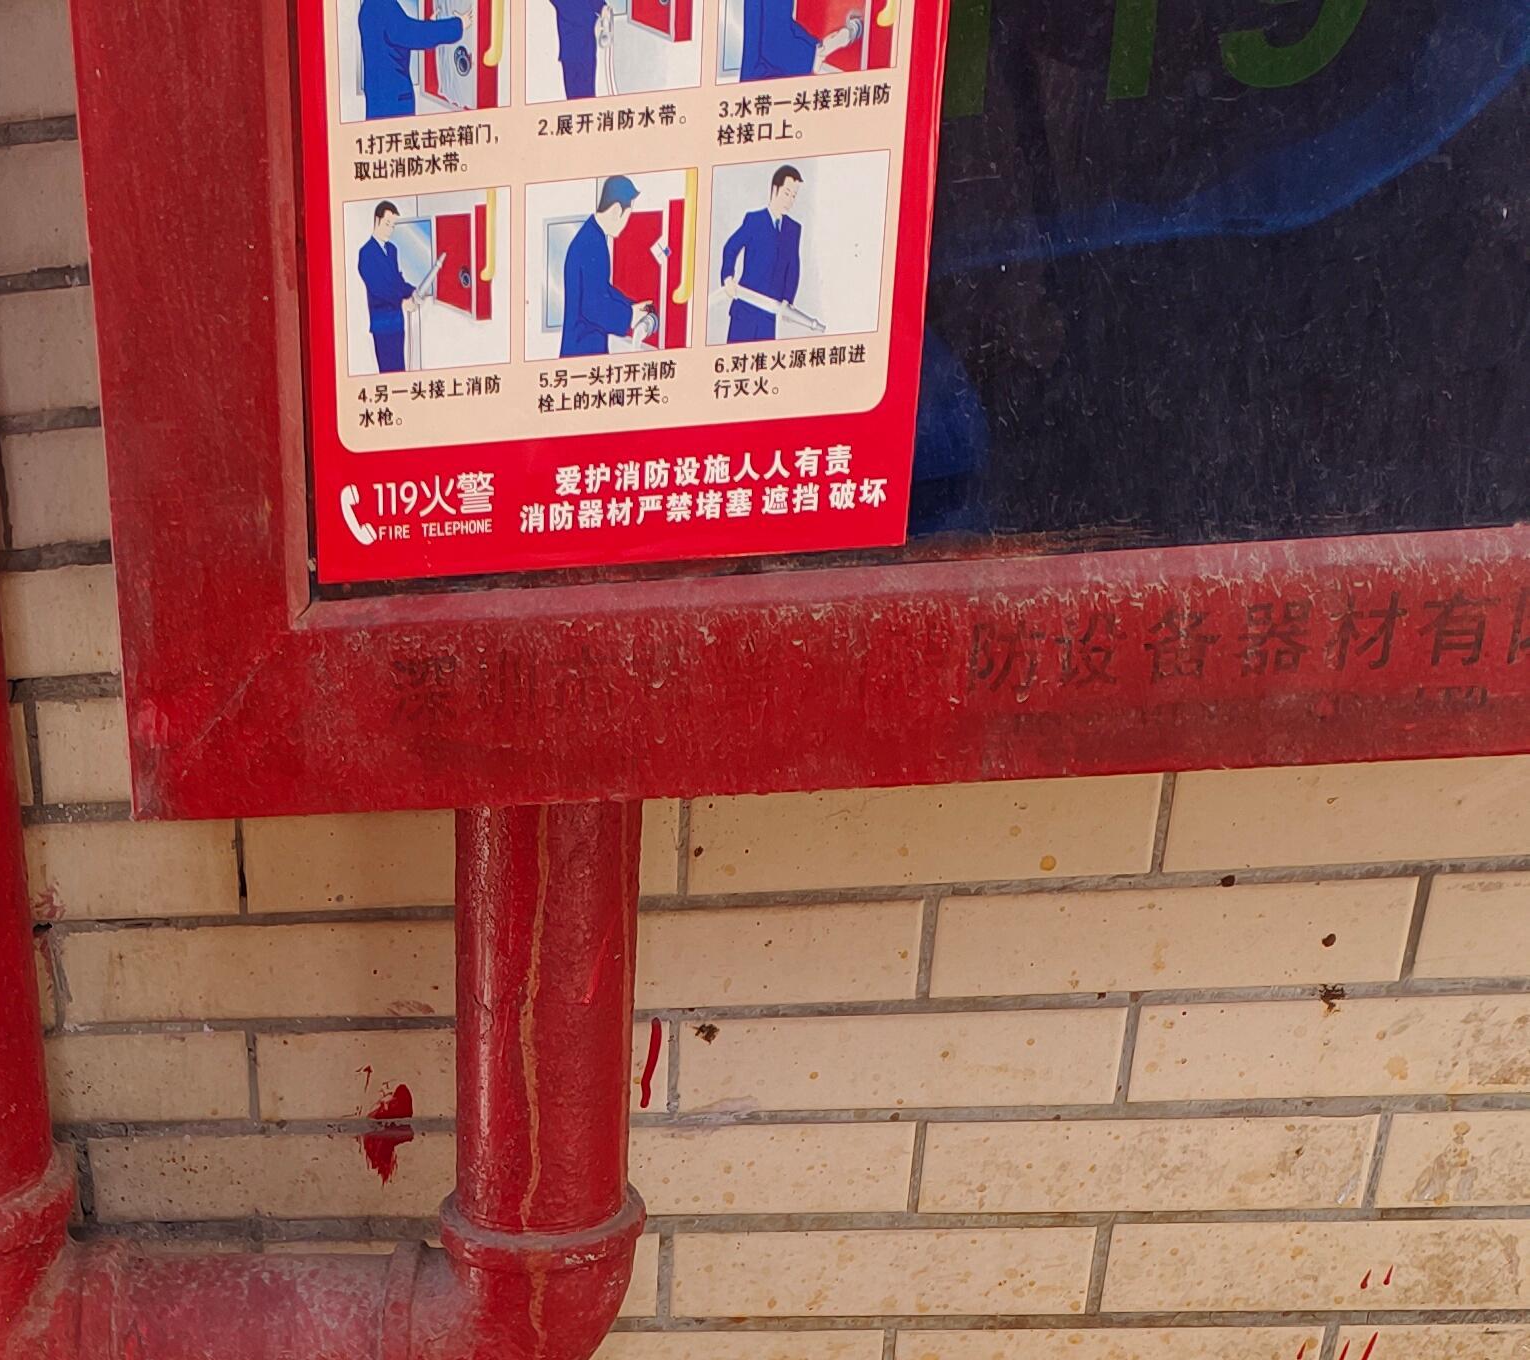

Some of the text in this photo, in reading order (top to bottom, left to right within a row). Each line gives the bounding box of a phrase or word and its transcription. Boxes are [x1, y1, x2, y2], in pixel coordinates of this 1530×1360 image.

[719, 83, 891, 120] 3.水带一头接到消防
[539, 104, 689, 137] 2.展开消防水带。
[717, 120, 803, 146] 栓接口上。
[354, 152, 468, 182] 取出消防水带。
[715, 344, 866, 374] 6.对准火源根部进
[539, 360, 676, 388] 5.另一头打开消防
[713, 375, 779, 399] 行灭火。
[358, 375, 501, 403] 4.另一头接上消防
[538, 386, 669, 413] 栓上的水阀开关。
[358, 407, 403, 428] 水枪。
[555, 444, 853, 497] 爱护消防设施人人有责
[373, 471, 495, 518] 119火警
[519, 477, 888, 534] 消防器材严禁堵塞 遮挡 破坏
[378, 518, 493, 541] FIRE TELEPHONE
